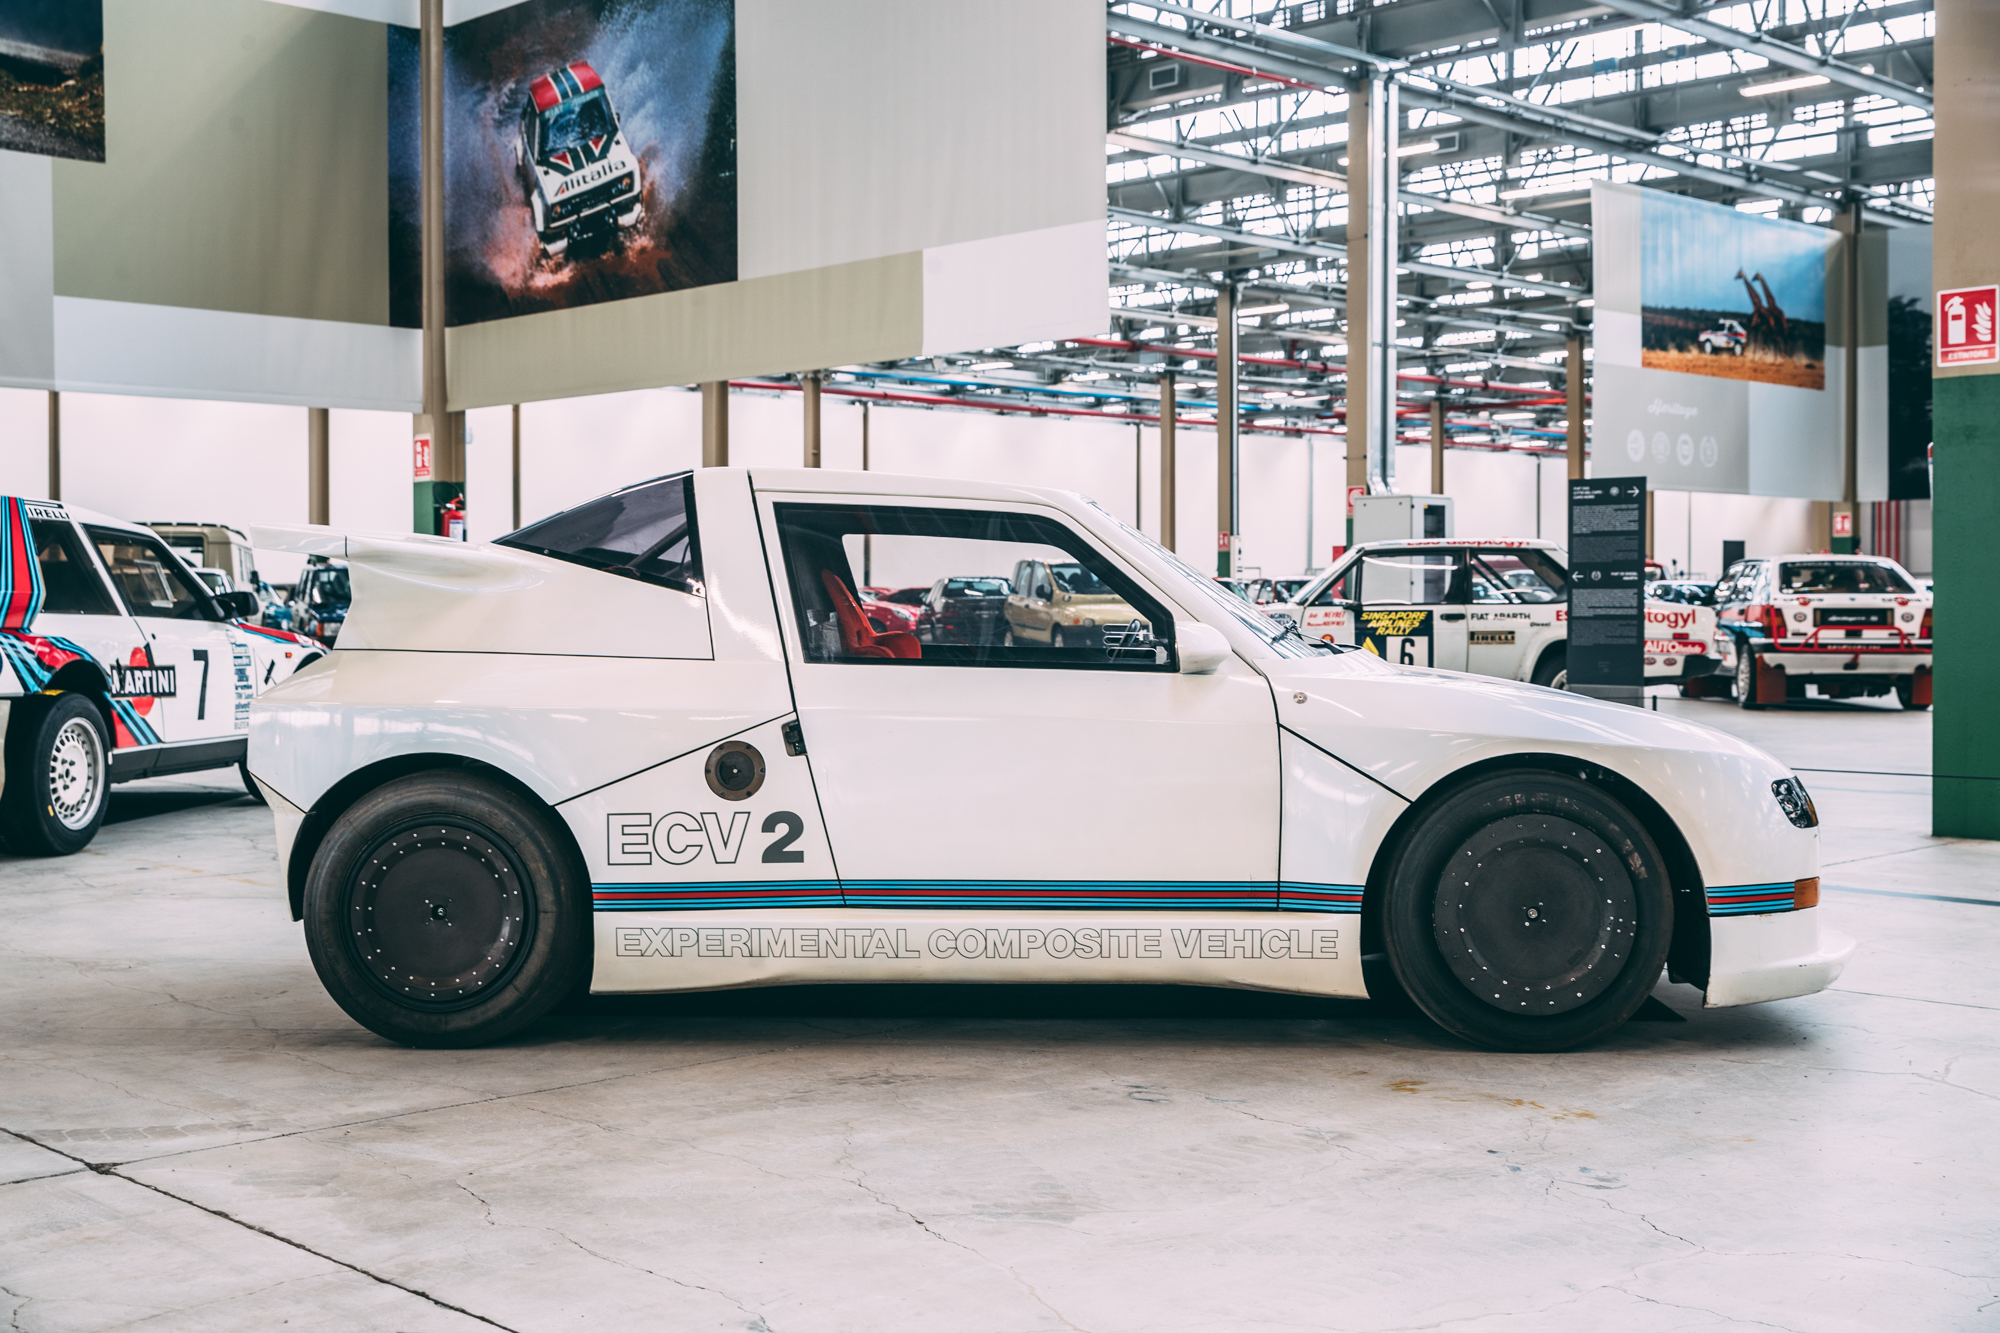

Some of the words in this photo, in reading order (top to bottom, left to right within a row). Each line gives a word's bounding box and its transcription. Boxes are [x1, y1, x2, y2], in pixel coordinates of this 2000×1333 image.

[554, 159, 626, 197] Alitalia
[1948, 349, 1989, 361] ESTINTORE
[1360, 611, 1428, 620] SINGAPORE
[1367, 619, 1420, 628] AIRLINES
[1645, 608, 1696, 629] togyl
[1376, 627, 1413, 635] RALLY
[1470, 631, 1515, 641] PIRELLI
[1400, 637, 1415, 665] 6
[193, 649, 209, 720] 7
[607, 811, 751, 866] ECV
[761, 810, 804, 863] 2
[615, 927, 920, 959] EXPERIMENTAL
[928, 928, 1162, 959] COMPOSITE
[1171, 929, 1339, 959] VEHICLE
